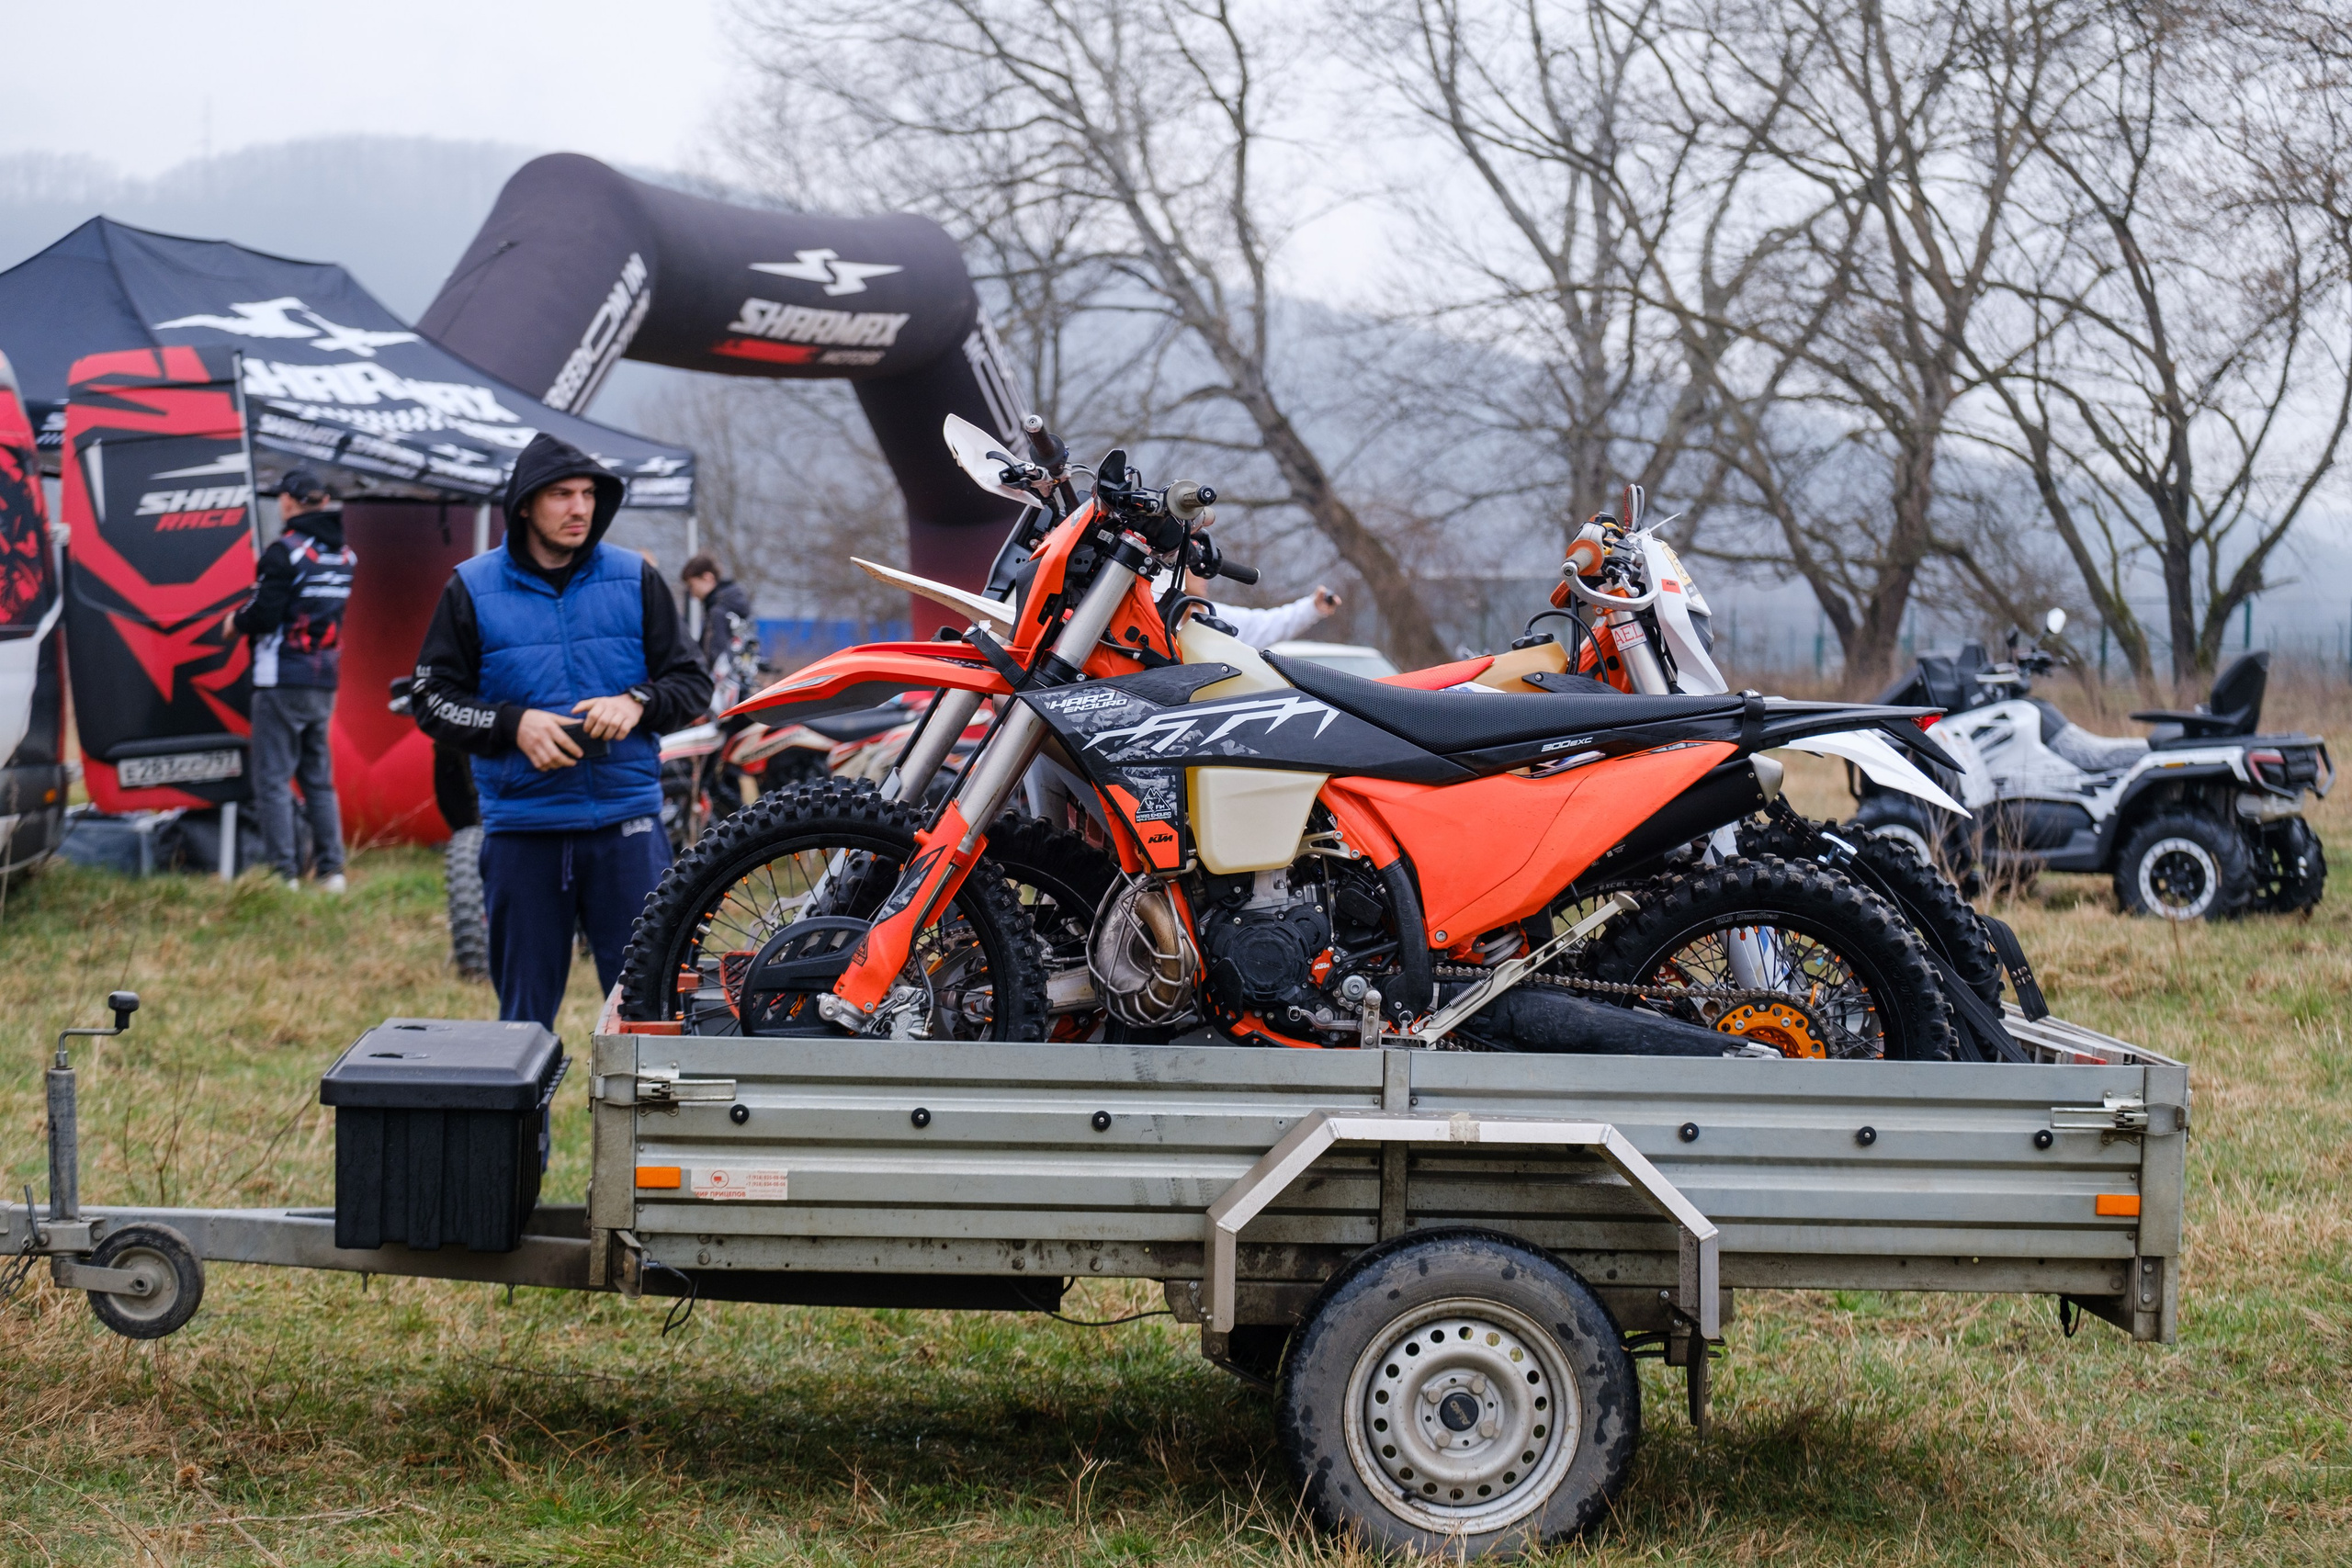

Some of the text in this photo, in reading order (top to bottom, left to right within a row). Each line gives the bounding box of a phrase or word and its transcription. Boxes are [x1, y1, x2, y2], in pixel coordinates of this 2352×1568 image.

[727, 298, 911, 346] SHARMAX
[154, 507, 246, 533] RACE
[1613, 623, 1645, 646] AEL
[1049, 692, 1116, 710] HARD
[1063, 698, 1128, 714] ENDURO
[1148, 833, 1173, 843] KTM
[1599, 881, 1628, 891] EXCEL
[1314, 962, 1330, 970] KTM
